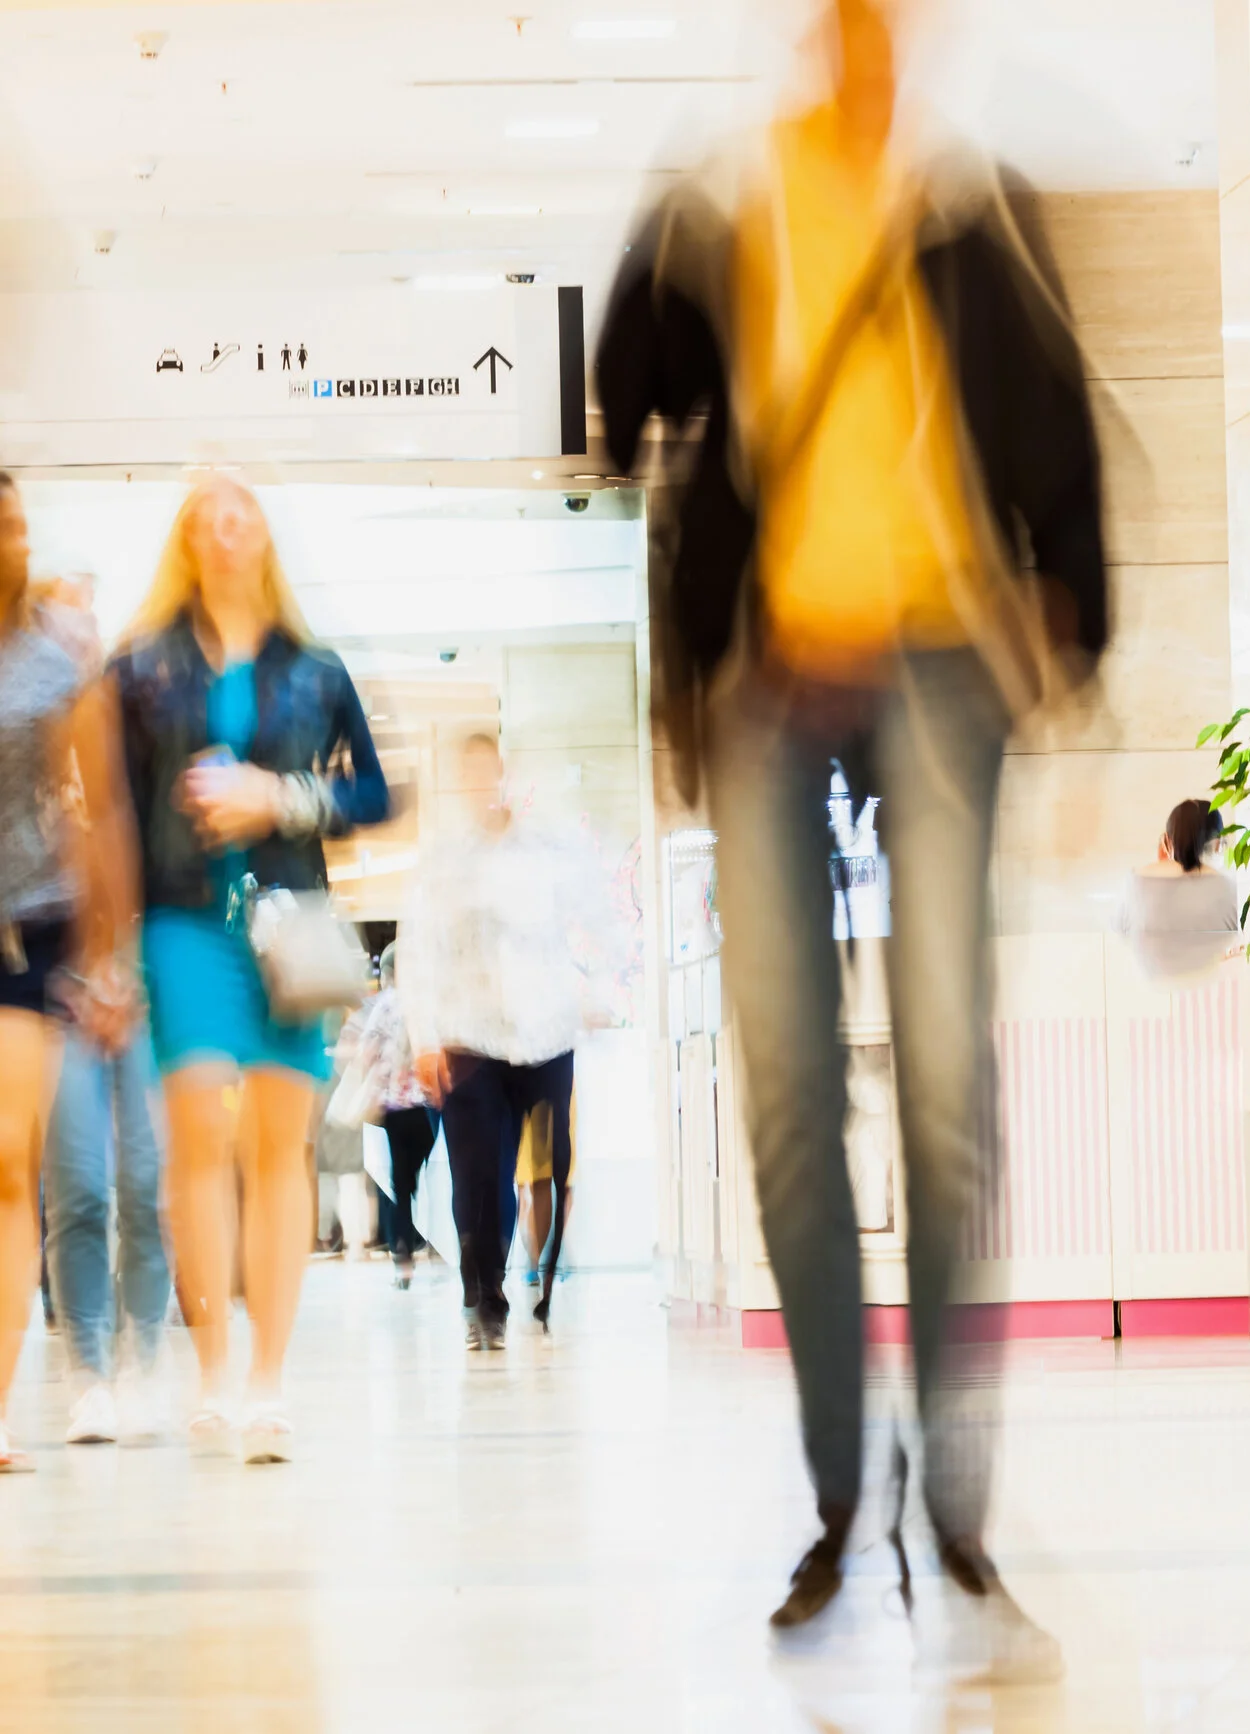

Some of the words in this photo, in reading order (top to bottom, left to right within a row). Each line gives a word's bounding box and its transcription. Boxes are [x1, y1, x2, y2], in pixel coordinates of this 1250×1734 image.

[316, 379, 330, 397] P
[338, 379, 352, 397] C
[362, 379, 376, 397] D
[386, 379, 398, 396] E
[409, 379, 420, 396] F
